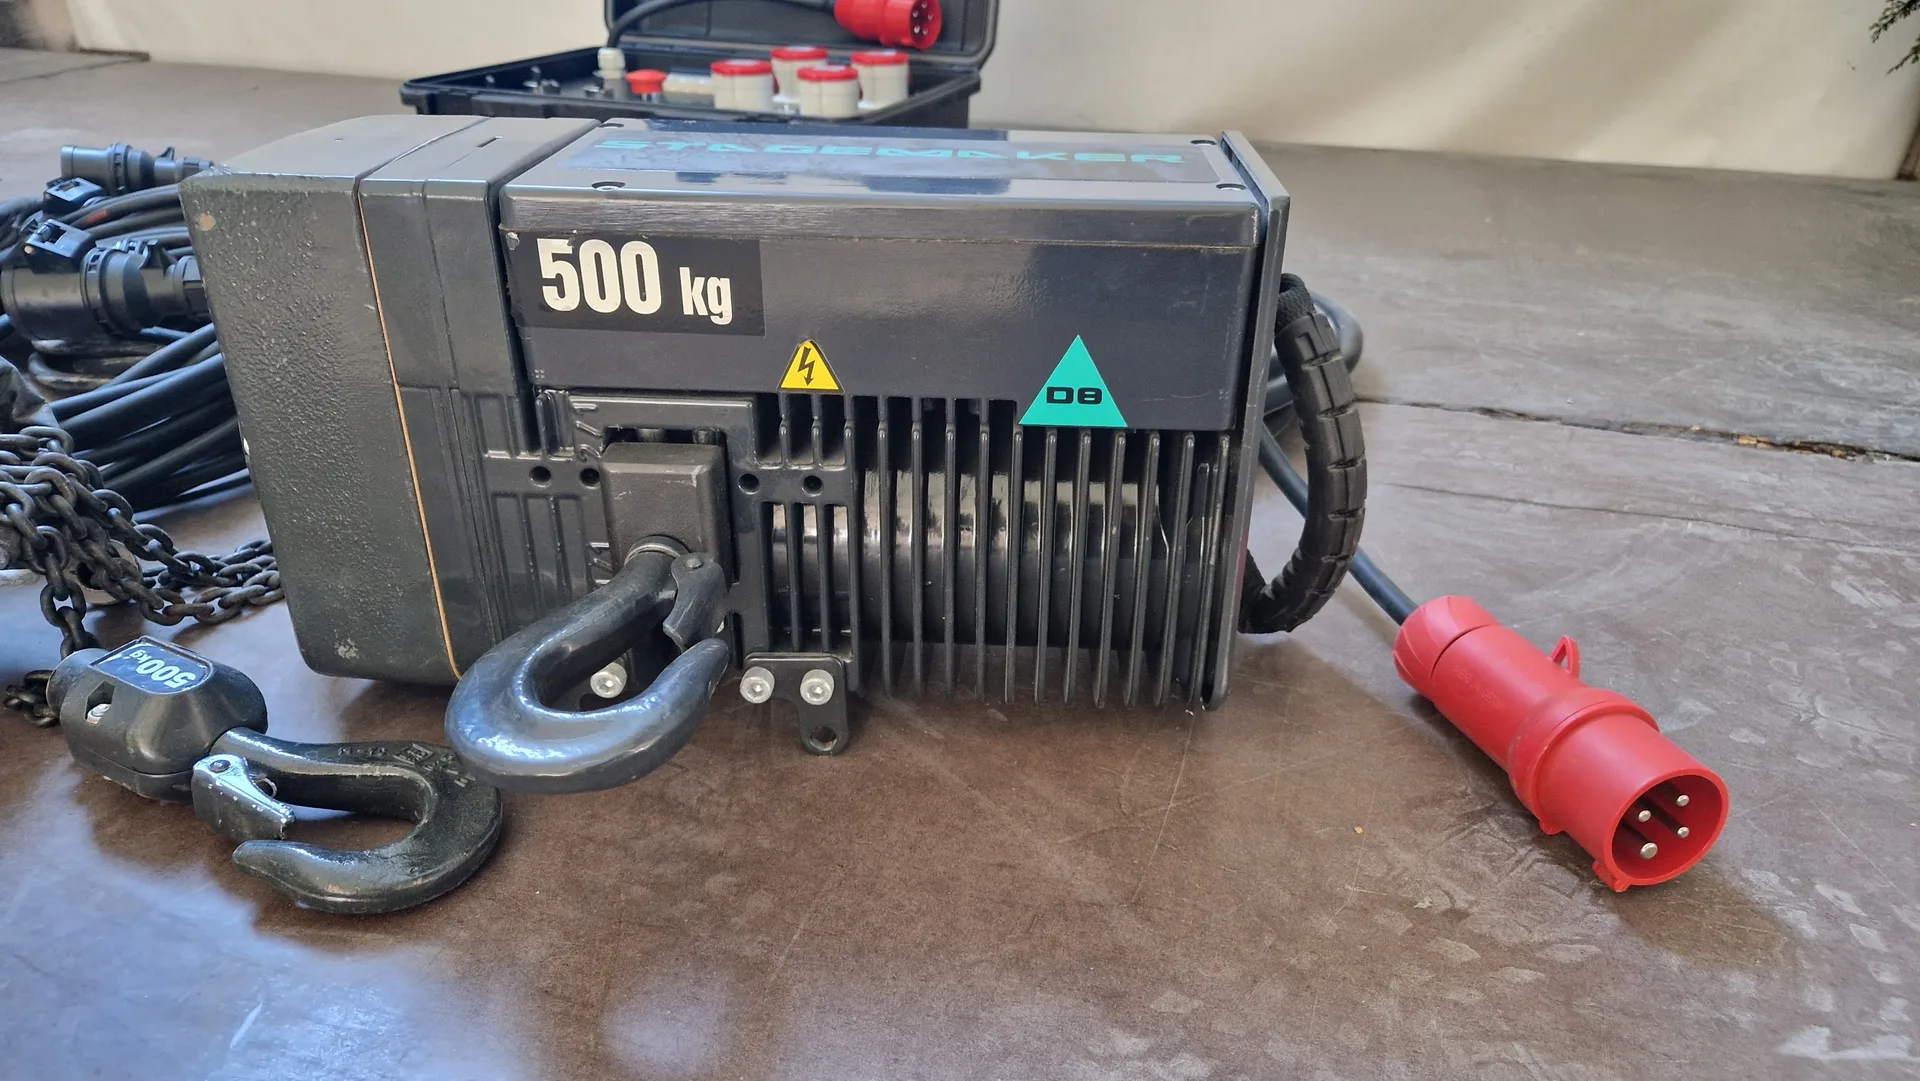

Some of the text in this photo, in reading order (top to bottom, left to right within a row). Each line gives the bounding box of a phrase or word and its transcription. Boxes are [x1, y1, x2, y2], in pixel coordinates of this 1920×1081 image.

[595, 139, 1186, 163] STAGEMAKER
[537, 238, 733, 325] 500 kg
[1046, 386, 1103, 405] D8
